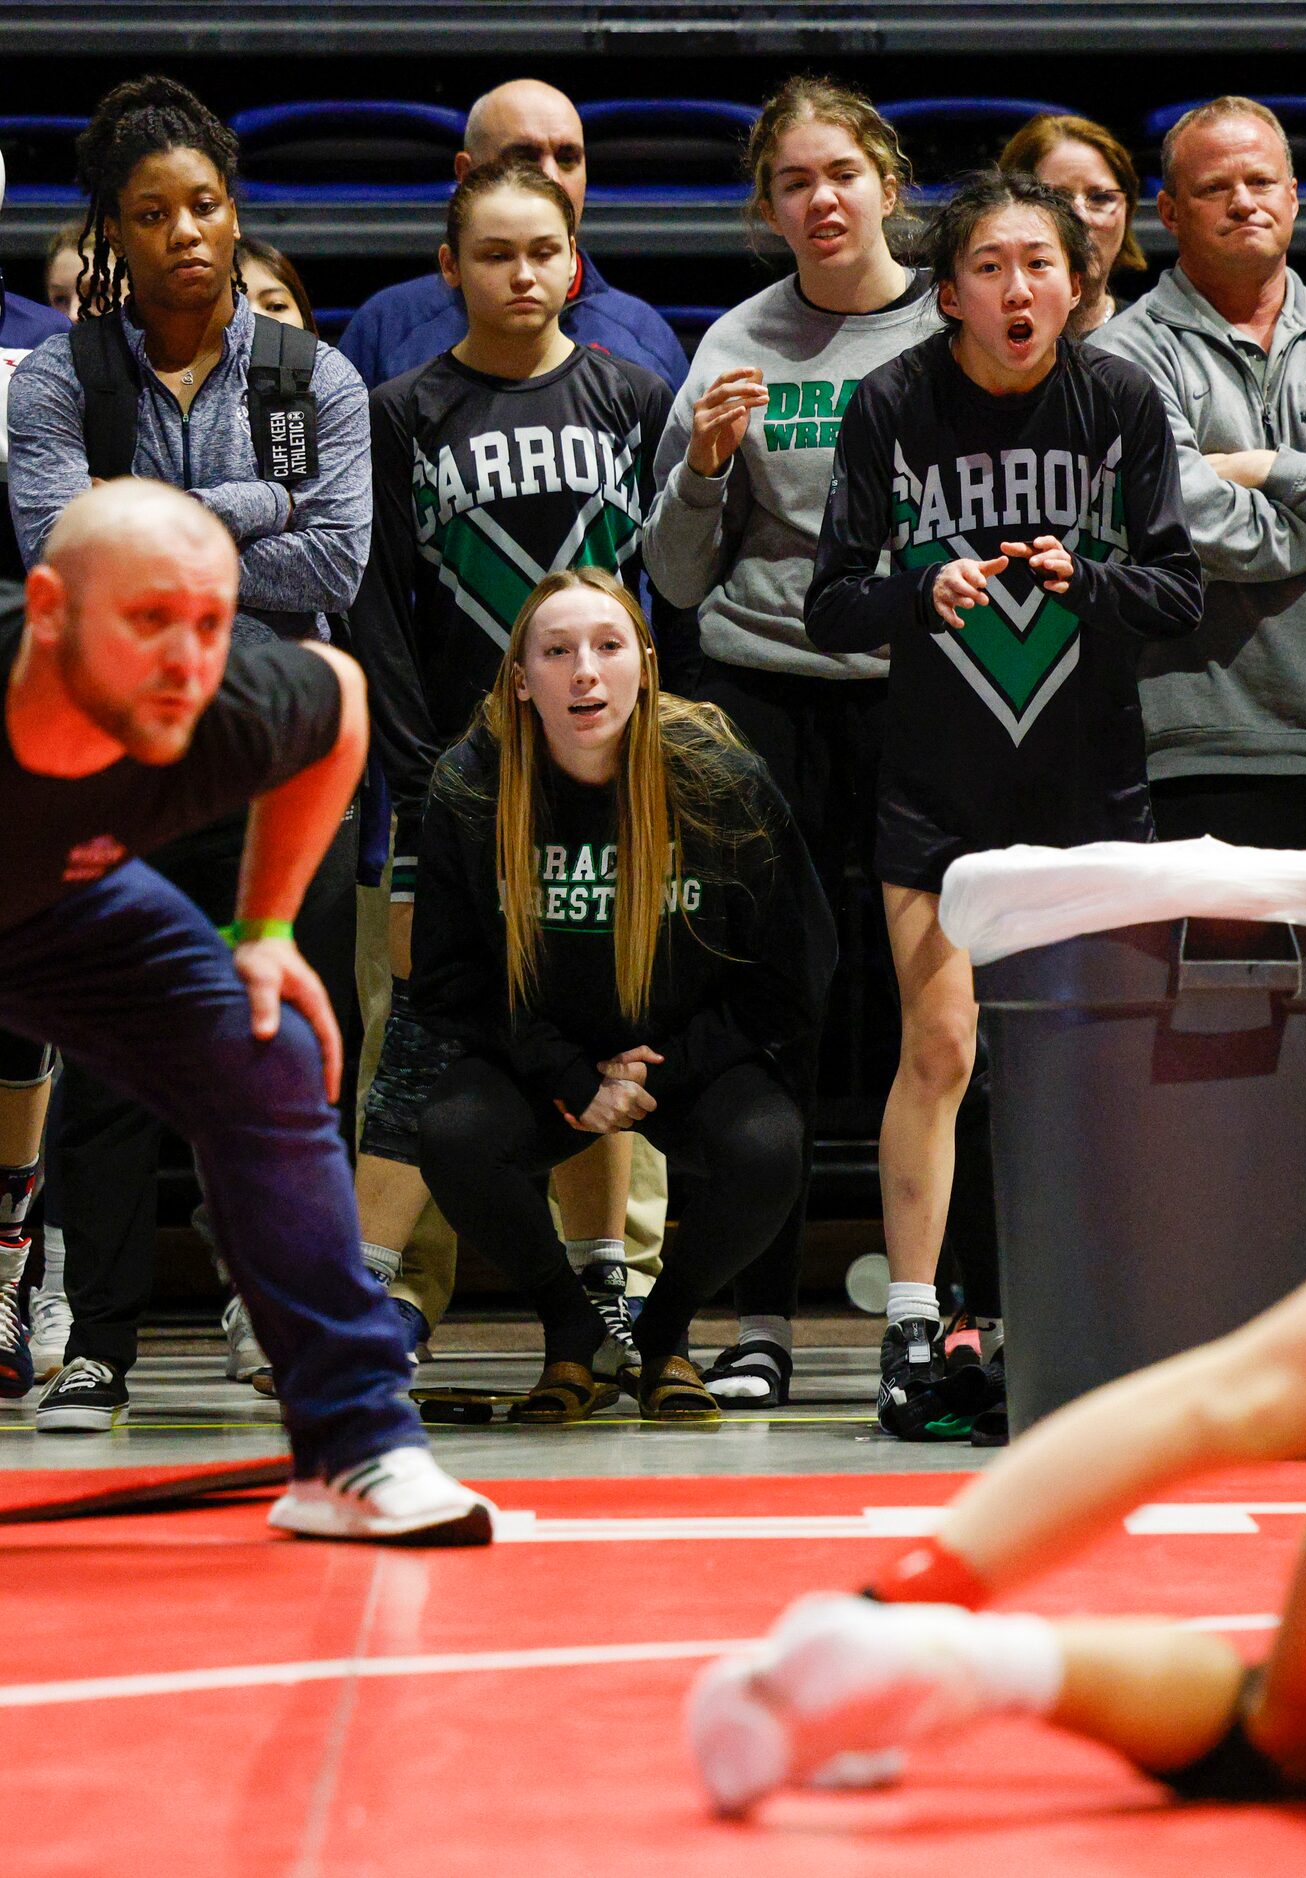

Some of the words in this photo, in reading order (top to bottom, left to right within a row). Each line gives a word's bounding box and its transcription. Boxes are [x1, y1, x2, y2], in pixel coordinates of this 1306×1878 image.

[270, 411, 287, 442] KEEN
[272, 445, 289, 477] CLIFF
[288, 421, 307, 474] ATHLETIC
[497, 878, 701, 921] ESTNG
